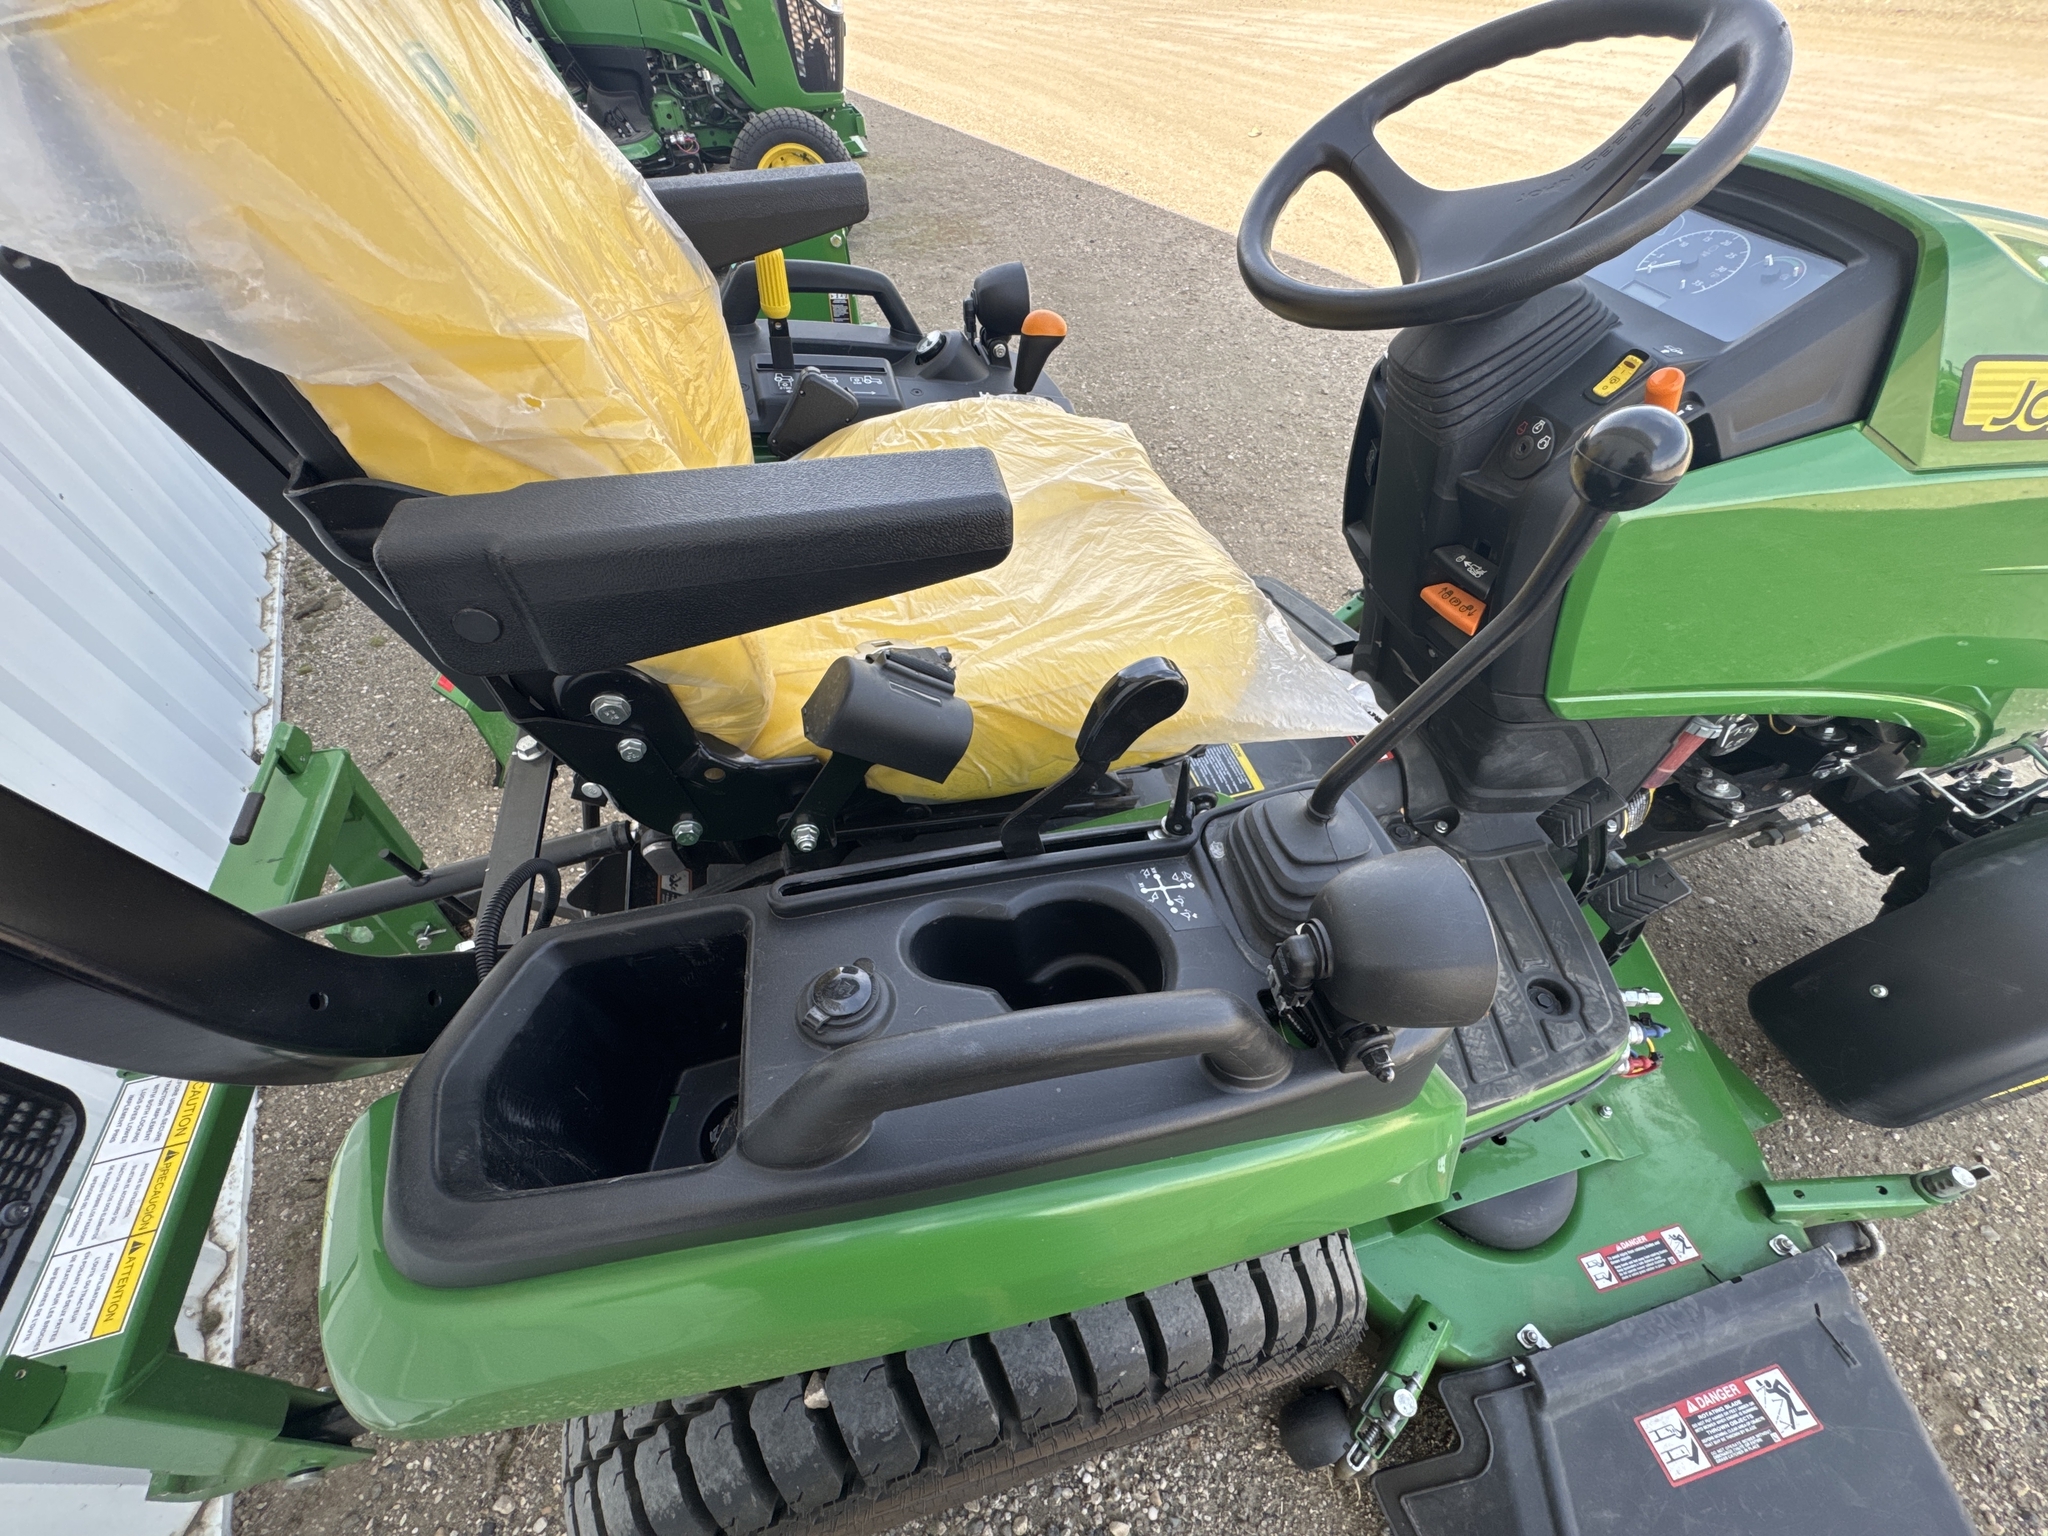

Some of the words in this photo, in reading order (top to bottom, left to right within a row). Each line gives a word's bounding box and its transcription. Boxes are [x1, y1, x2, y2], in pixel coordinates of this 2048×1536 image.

[1516, 173, 1576, 202] JOHN
[1579, 103, 1656, 172] DEERE
[173, 1081, 205, 1136] CAUTION
[137, 1161, 173, 1230] PRECAUCIÓN
[1620, 1235, 1648, 1249] DANGER
[102, 1254, 137, 1323] ATTENTION
[1695, 1383, 1741, 1409] DANGER
[1697, 1406, 1724, 1420] ROTATING
[1723, 1399, 1742, 1409] BLADE
[1706, 1423, 1730, 1435] THROWN
[1729, 1413, 1754, 1426] OBJECTS
